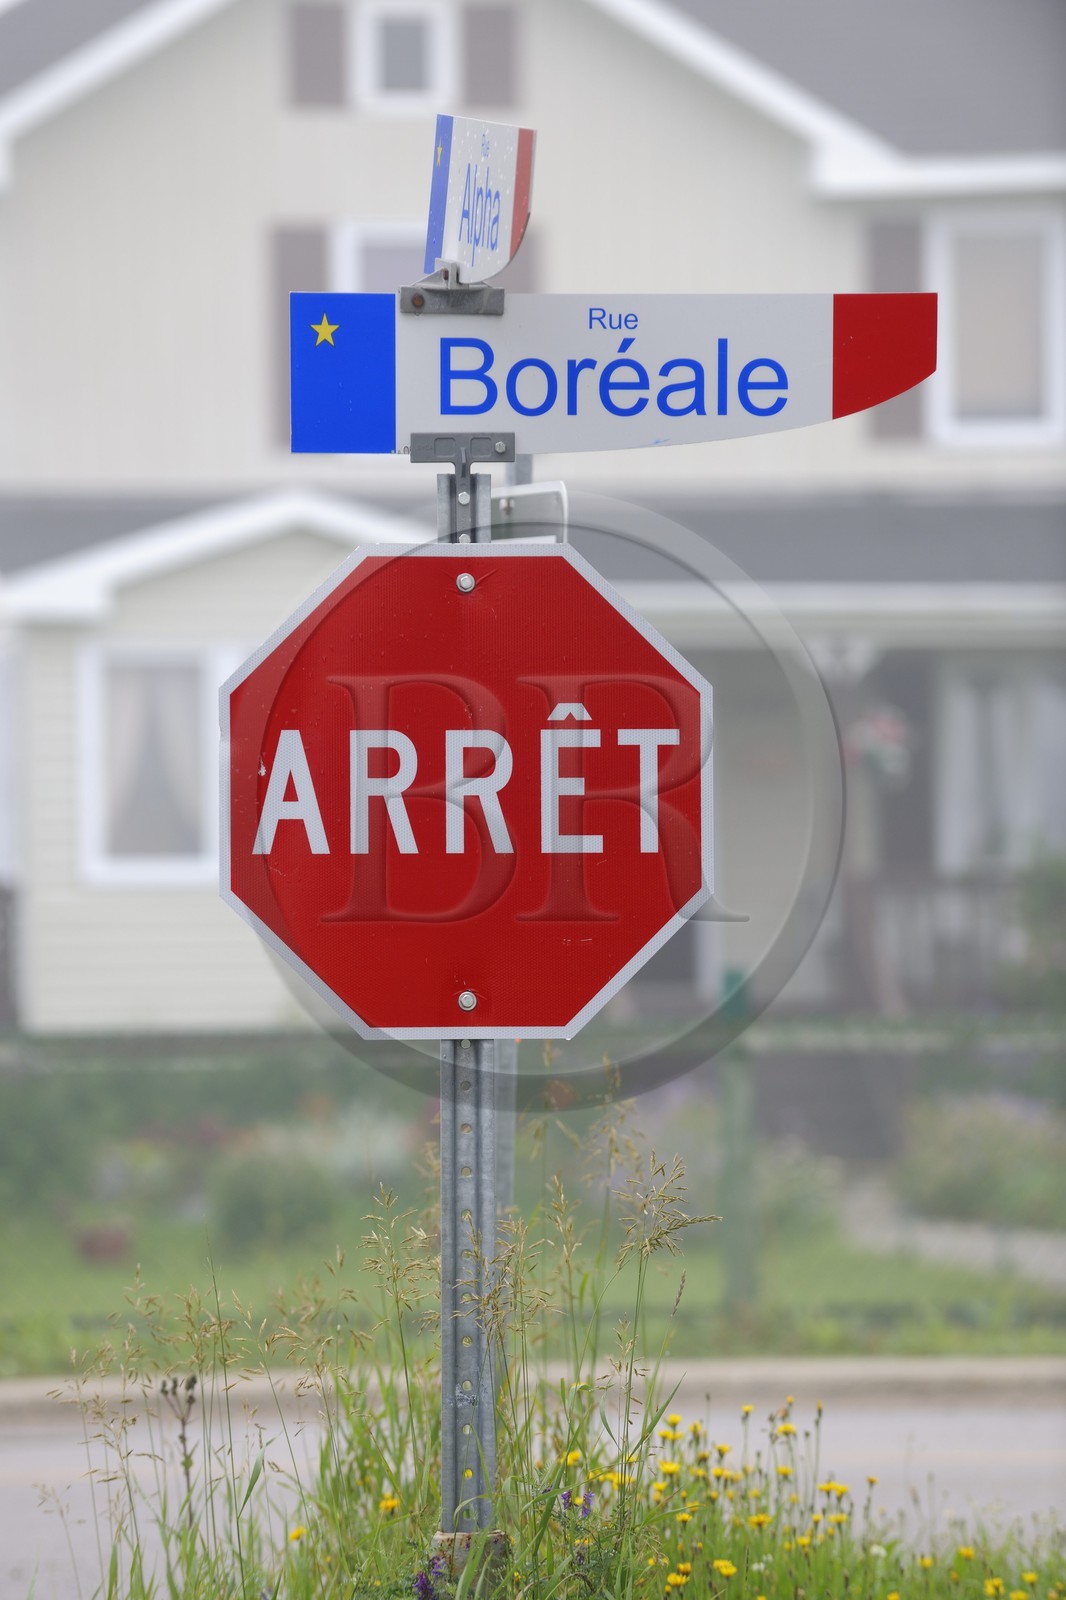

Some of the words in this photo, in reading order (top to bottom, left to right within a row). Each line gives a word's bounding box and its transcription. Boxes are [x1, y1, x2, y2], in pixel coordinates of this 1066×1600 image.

[481, 133, 491, 158] Rue
[458, 163, 501, 268] Alpha
[588, 307, 639, 330] Rue
[439, 337, 790, 417] Boréale
[251, 702, 681, 855] ARRÊT
